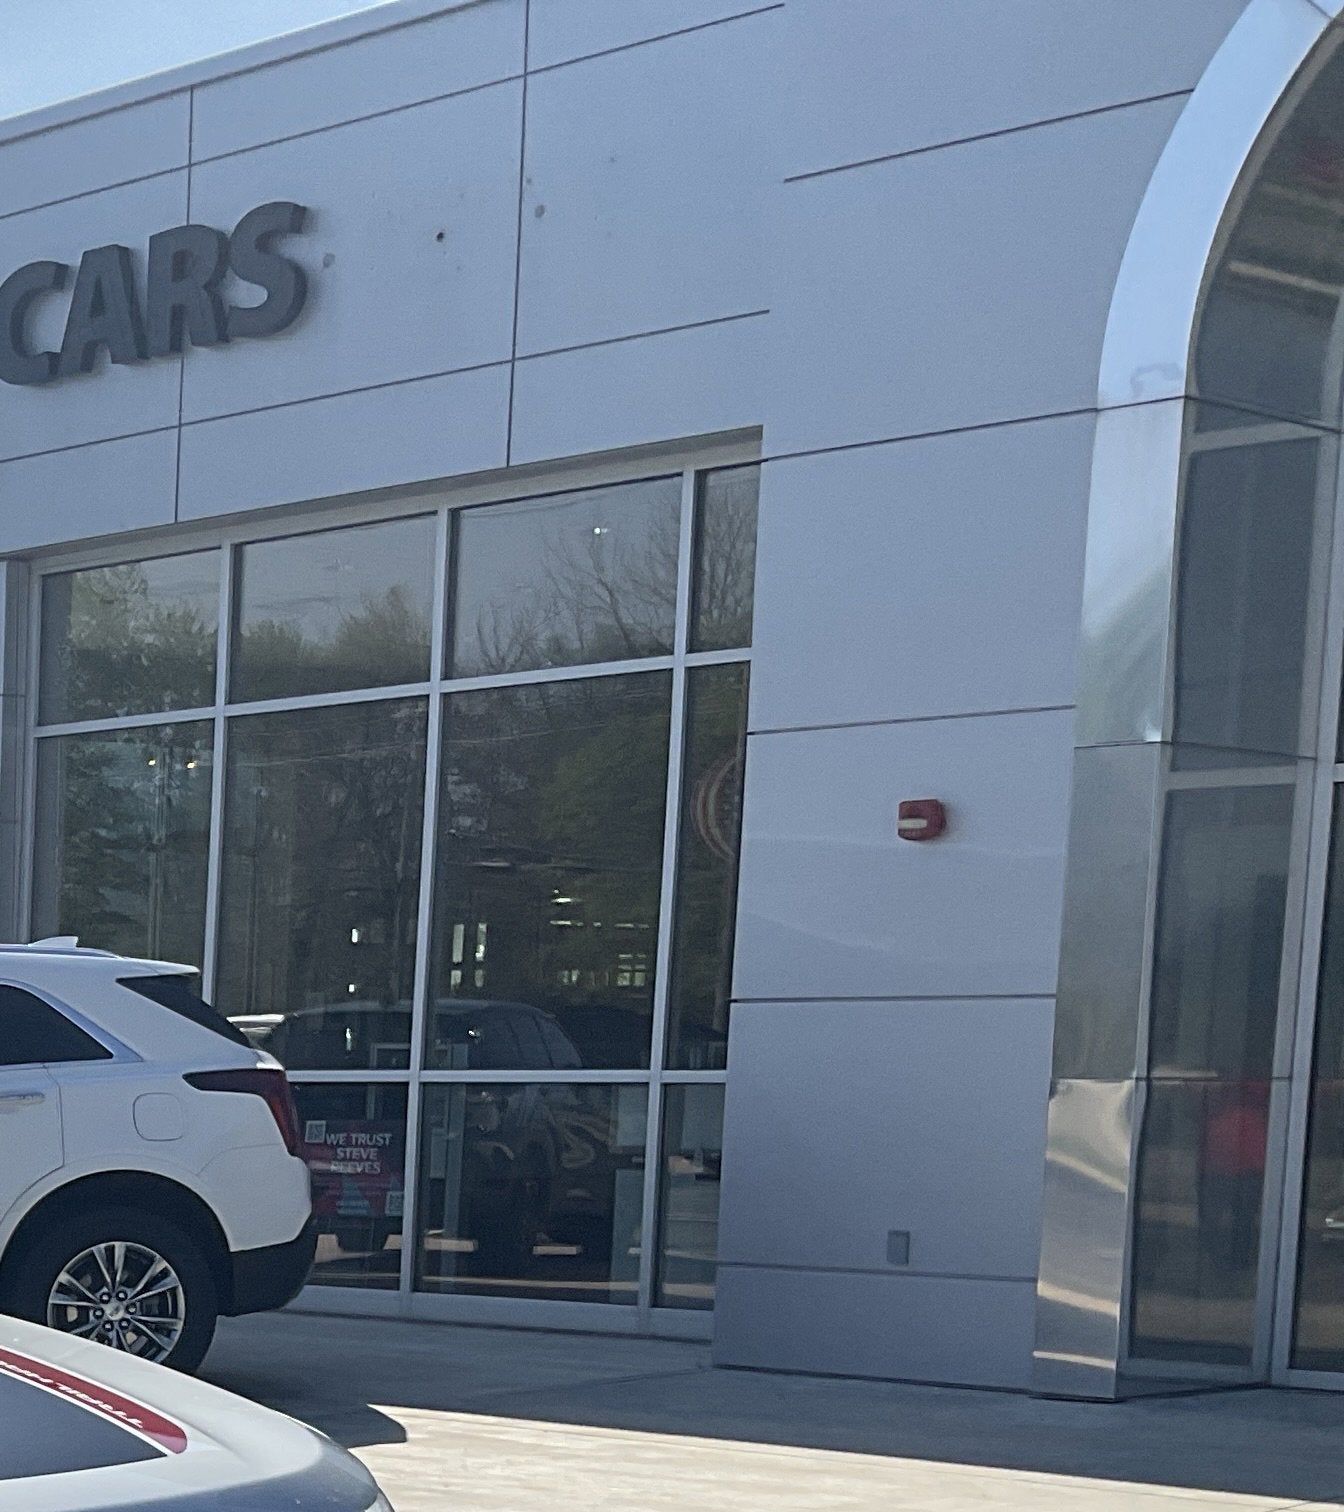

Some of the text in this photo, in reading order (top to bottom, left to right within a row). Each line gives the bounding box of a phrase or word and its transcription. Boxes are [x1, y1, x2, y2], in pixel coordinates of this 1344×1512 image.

[325, 1132, 392, 1147] WE TRUST
[336, 1147, 378, 1160] STEVE
